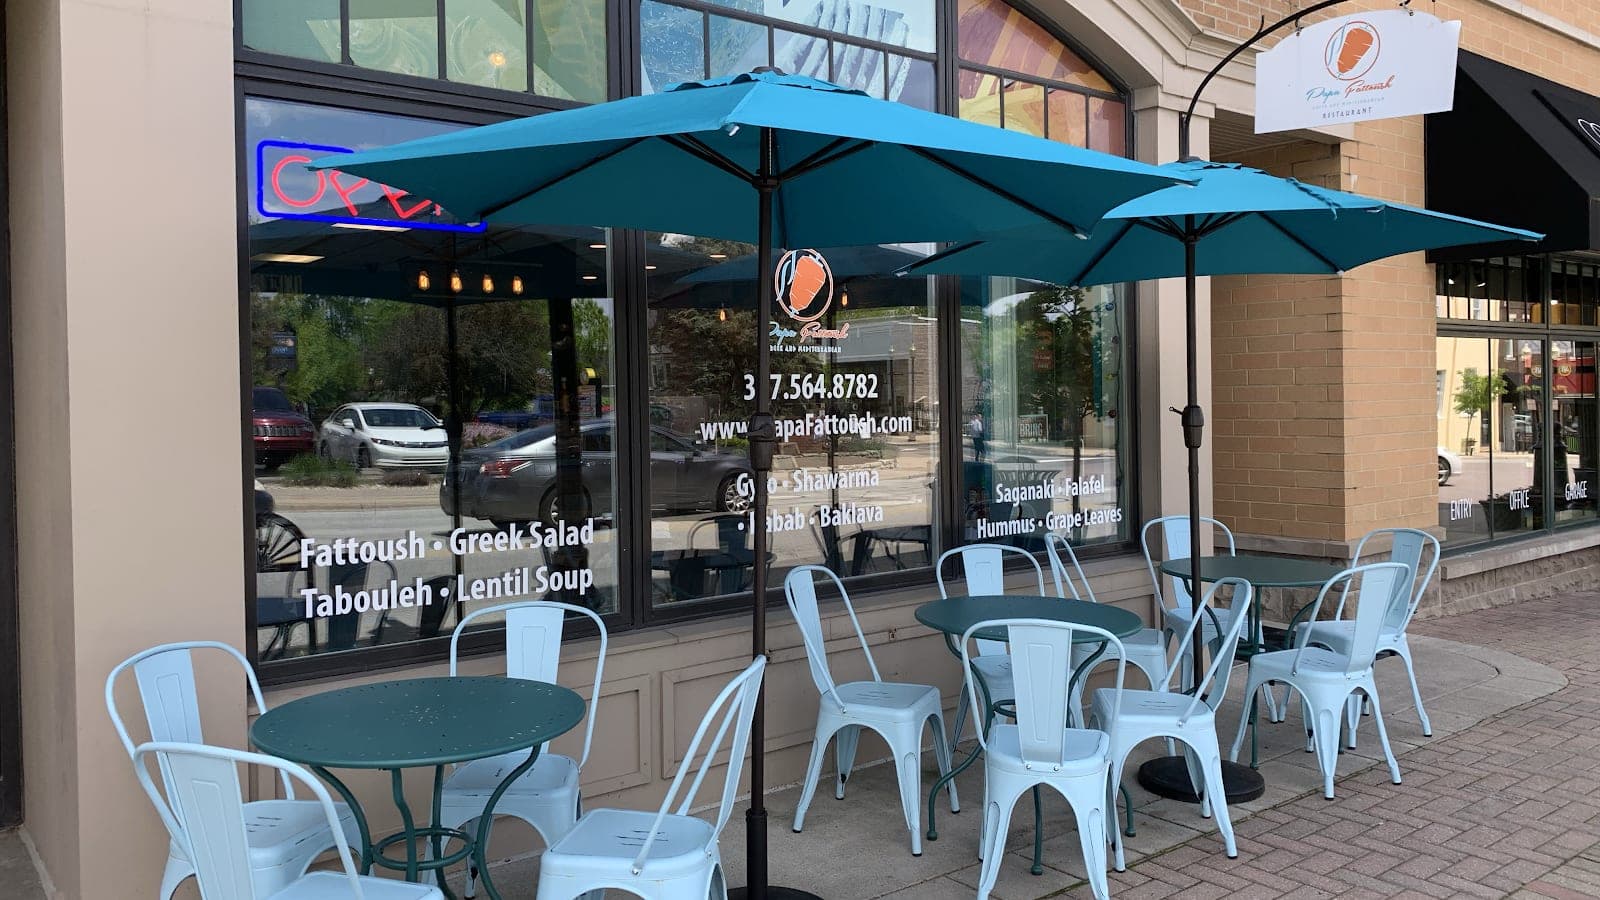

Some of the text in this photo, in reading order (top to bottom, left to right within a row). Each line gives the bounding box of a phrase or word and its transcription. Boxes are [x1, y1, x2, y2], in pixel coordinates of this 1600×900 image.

[1344, 75, 1395, 99] Fattoush
[1322, 106, 1373, 119] RESTAURANT
[271, 155, 441, 219] OPE
[743, 373, 878, 401] 37.564.8782
[700, 411, 913, 442] wwwapaFattoush.com
[736, 468, 880, 503] Gyo Shawarma
[995, 475, 1105, 507] Saganaki Falafel
[1509, 489, 1530, 511] OFFICE
[1565, 480, 1588, 501] GARAGE
[820, 503, 884, 528] Baklava
[977, 508, 1122, 539] Hummus Grape Leaves
[1450, 498, 1473, 521] ENTRY
[300, 518, 595, 568] Fattoush Greek Salad
[300, 566, 594, 619] Tabouleh Lentil Soup
